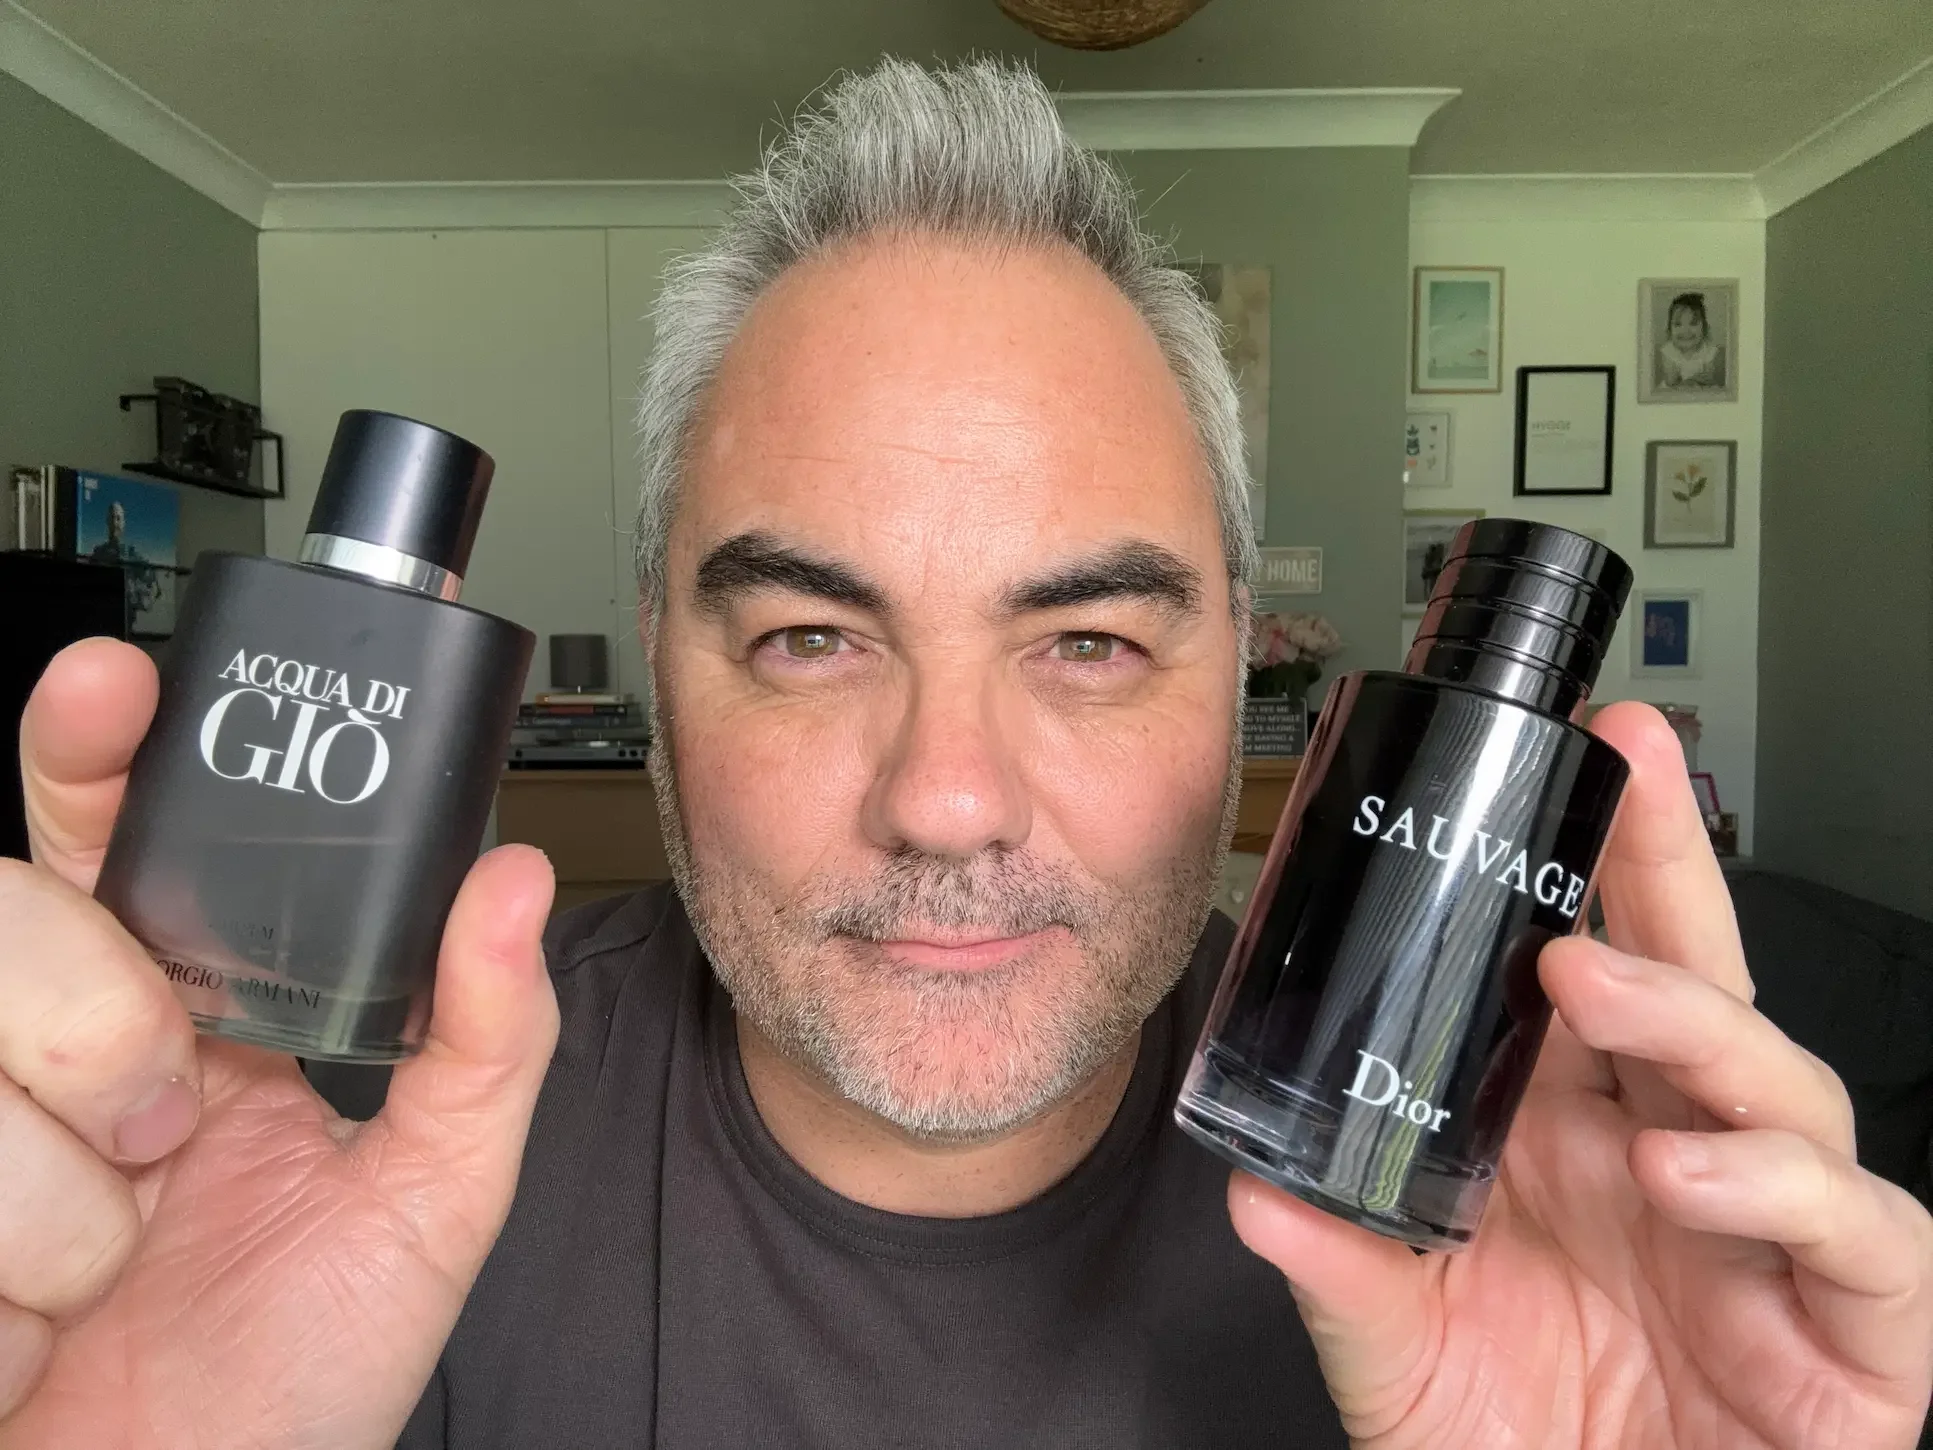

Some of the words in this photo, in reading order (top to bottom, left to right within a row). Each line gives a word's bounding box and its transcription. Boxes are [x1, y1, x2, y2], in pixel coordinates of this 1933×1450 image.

[1267, 559, 1318, 582] HOME
[218, 648, 353, 708] ACQUA
[360, 679, 412, 720] DI
[199, 687, 390, 805] GIÒ
[1352, 794, 1586, 919] SAUVAGE
[1342, 1048, 1451, 1133] Dior
